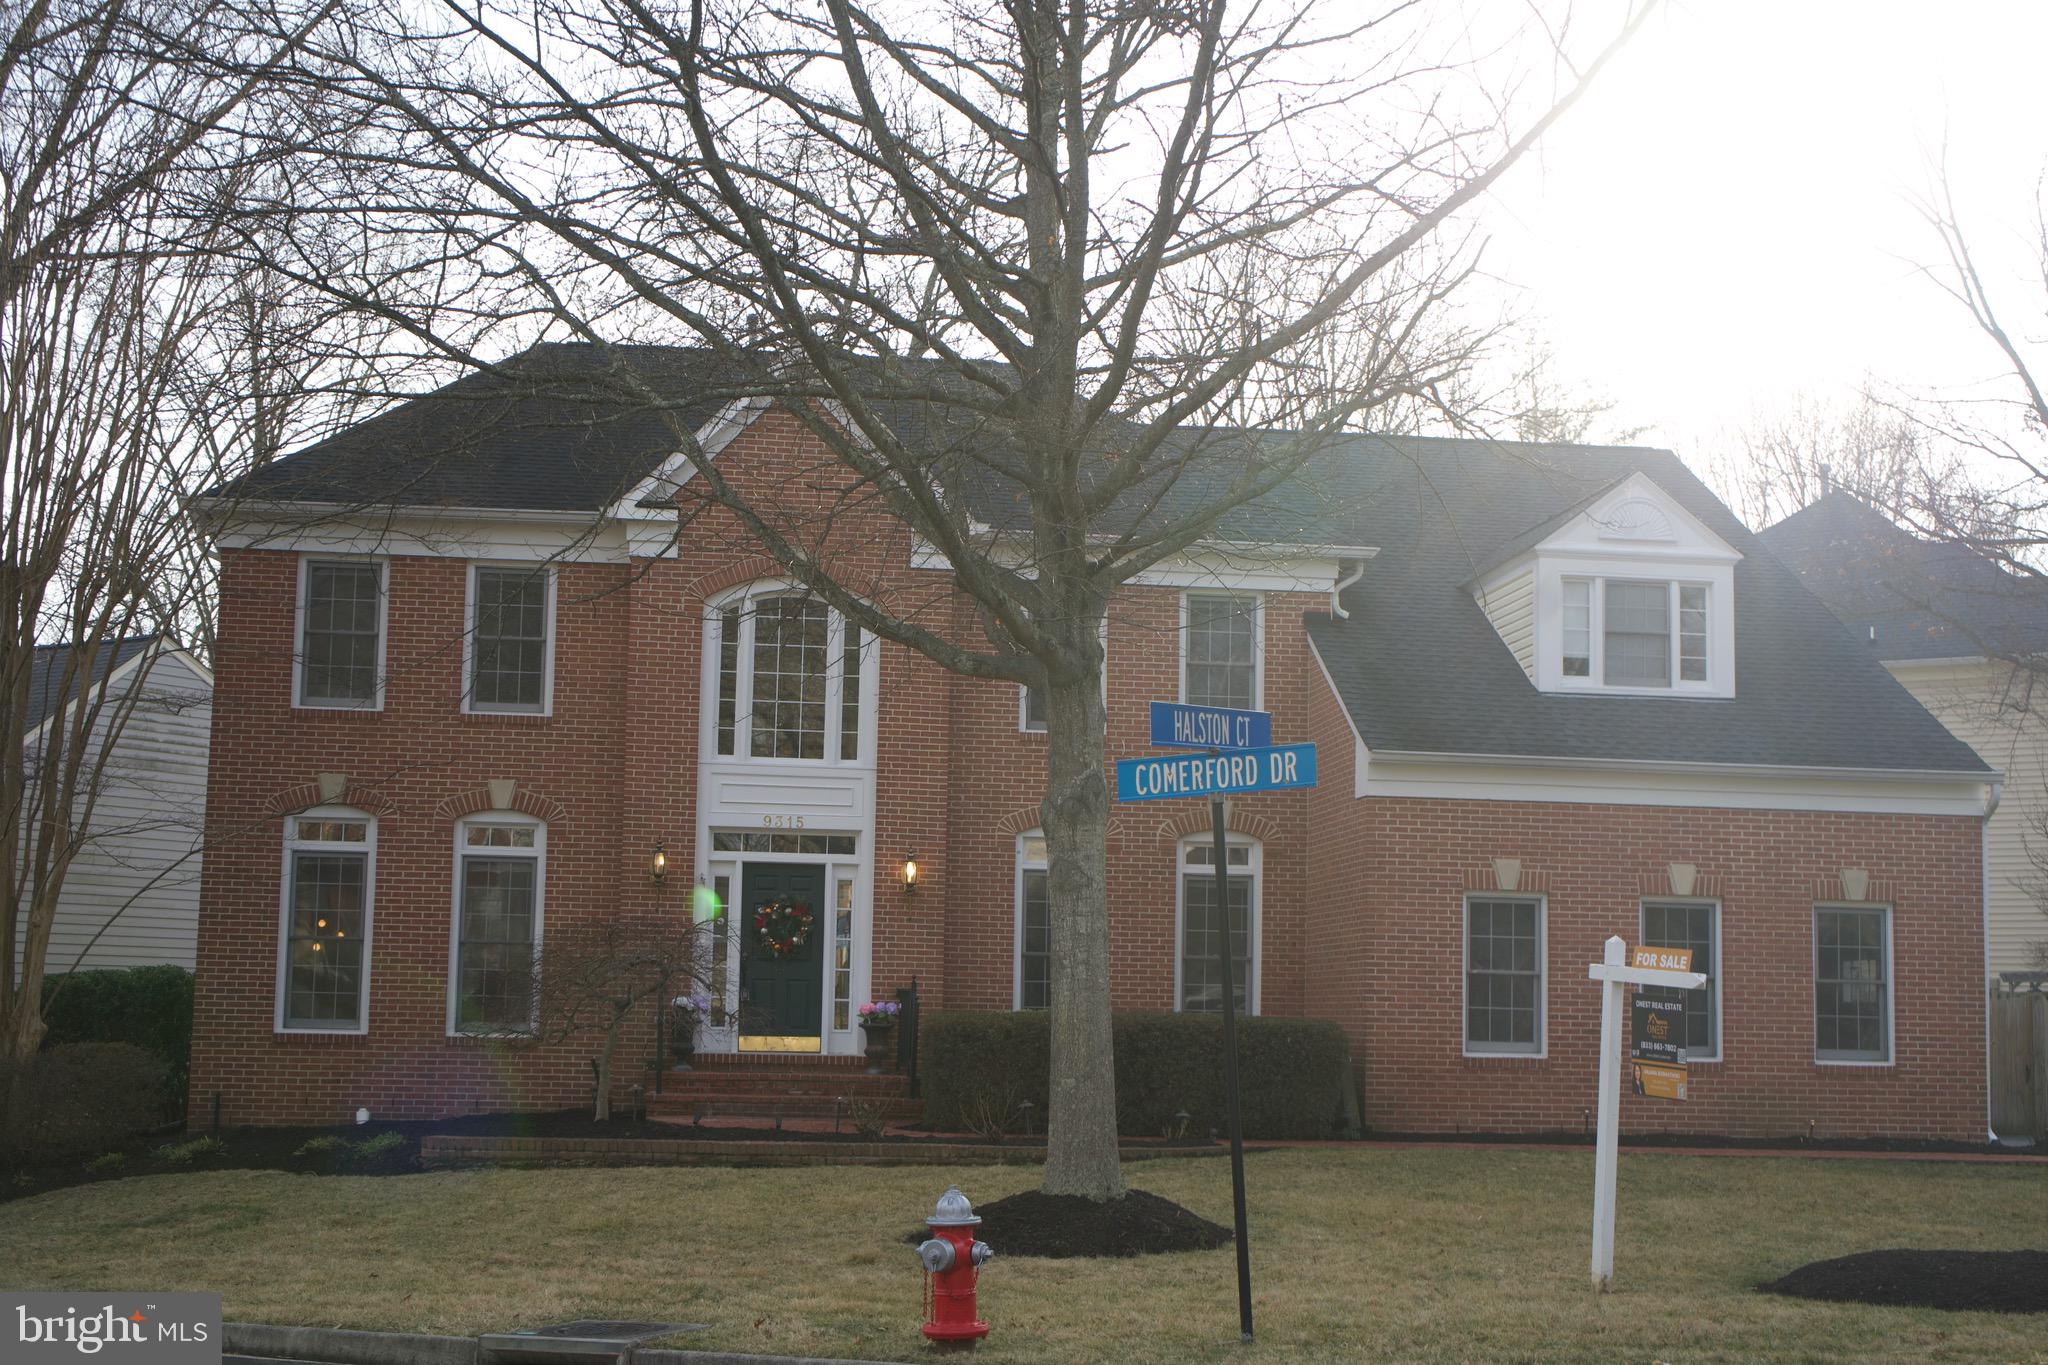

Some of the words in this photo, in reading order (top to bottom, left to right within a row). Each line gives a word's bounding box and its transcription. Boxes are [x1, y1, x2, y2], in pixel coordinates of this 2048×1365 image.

[1174, 710, 1230, 745] HALSTON
[1236, 715, 1251, 747] CT
[1135, 755, 1258, 795] COMERFORD
[1270, 751, 1297, 784] DR
[763, 815, 805, 829] 9315
[1636, 953, 1658, 967] FOR
[1659, 955, 1688, 969] SALE
[1635, 1000, 1651, 1008] ONEST
[1652, 1001, 1664, 1009] REAL
[1664, 1003, 1682, 1011] ESTATE
[1646, 1023, 1669, 1035] ONEST
